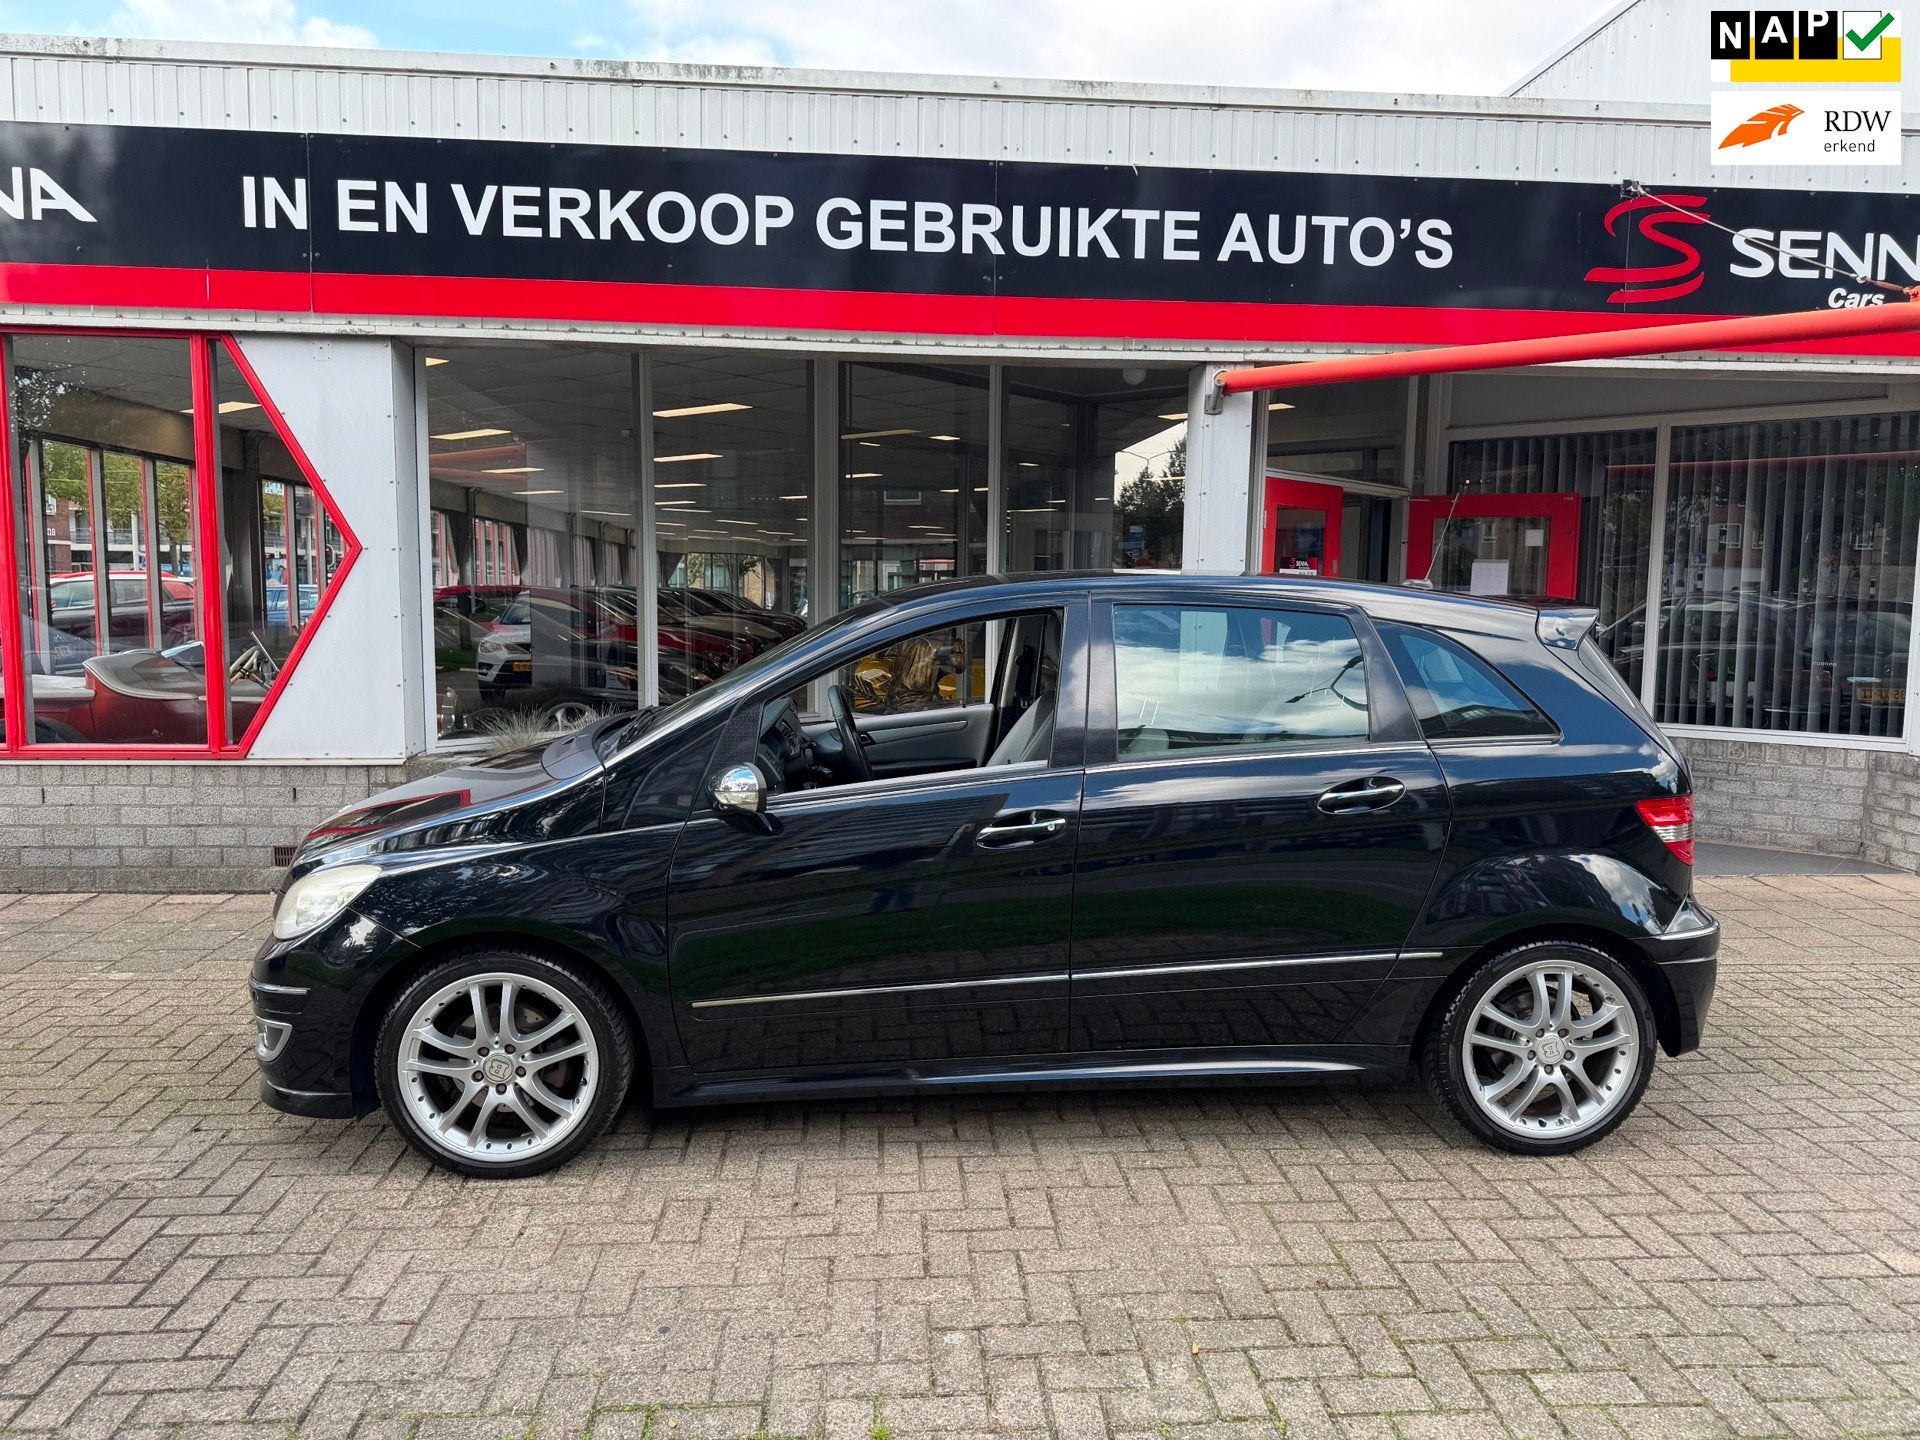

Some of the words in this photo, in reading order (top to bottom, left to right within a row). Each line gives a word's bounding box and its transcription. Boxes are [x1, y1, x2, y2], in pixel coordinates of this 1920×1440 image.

[242, 176, 308, 230] IN
[337, 179, 428, 234] EN
[450, 183, 794, 247] VERKOOP
[816, 197, 1200, 261] GEBRUIKTE
[1216, 212, 1454, 269] AUTO’S
[1827, 287, 1885, 308] Cars
